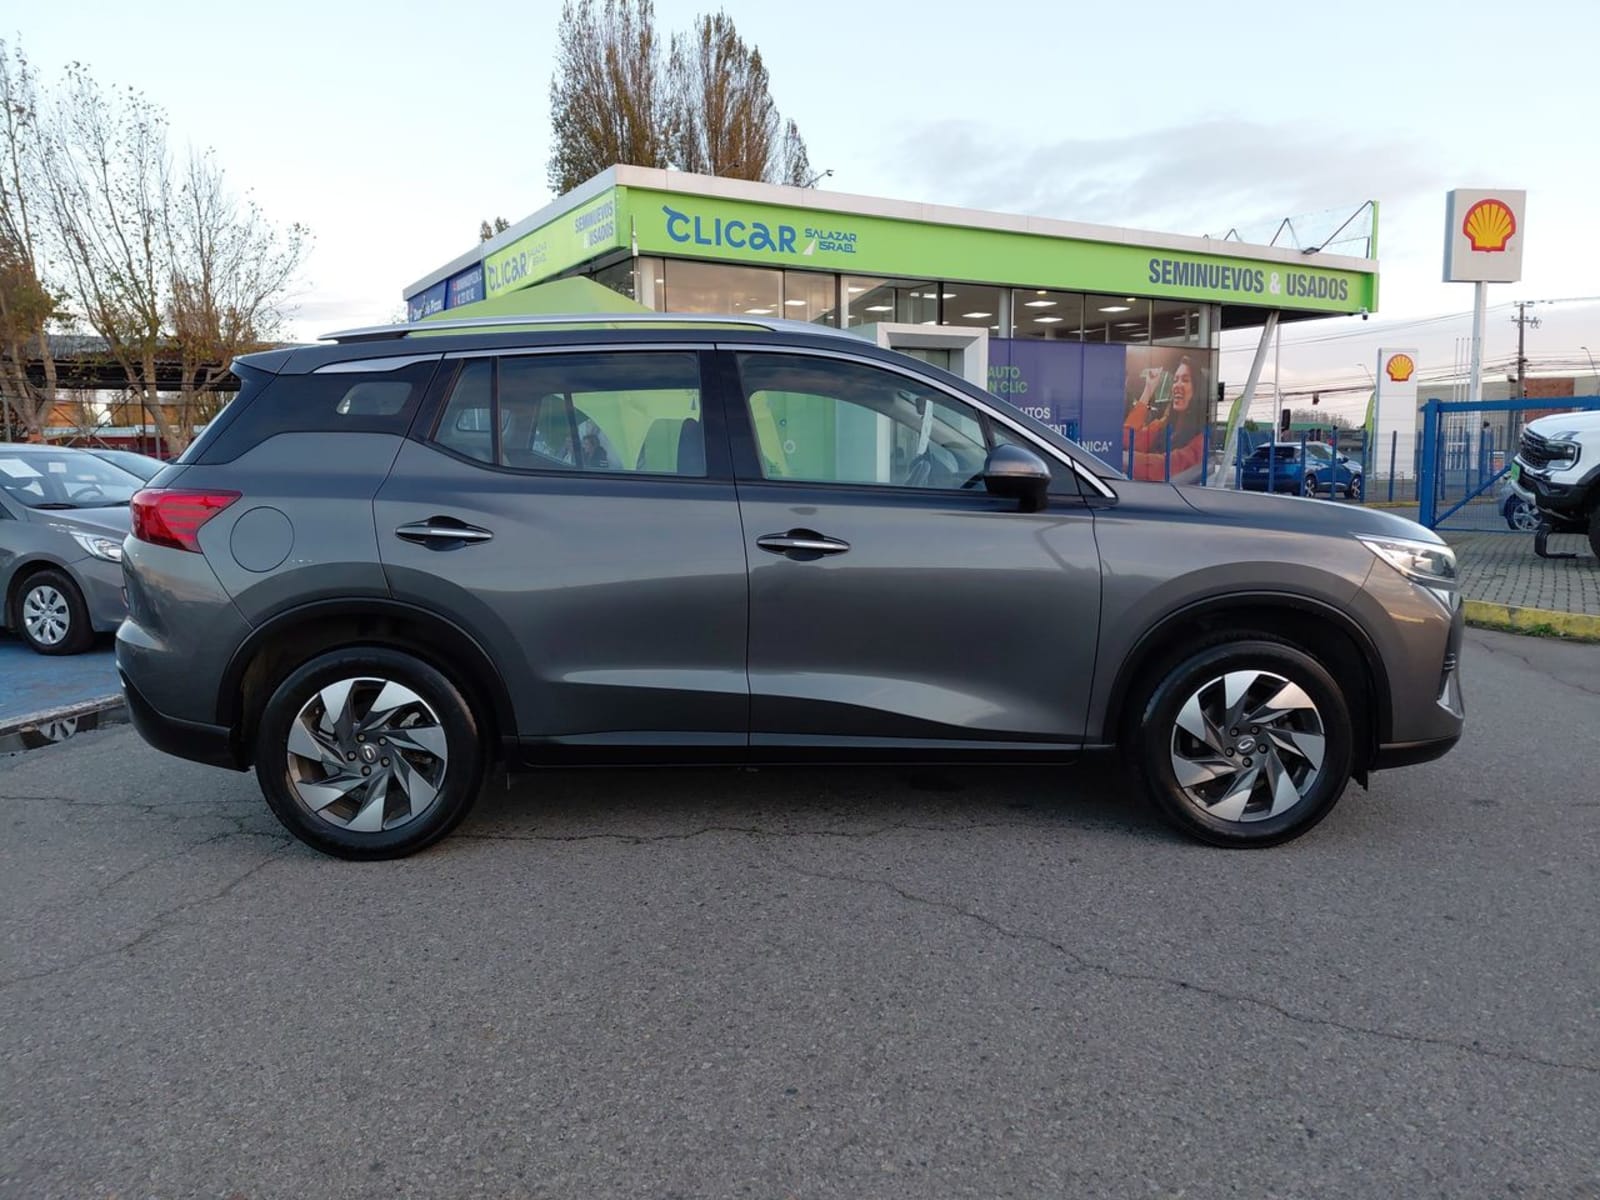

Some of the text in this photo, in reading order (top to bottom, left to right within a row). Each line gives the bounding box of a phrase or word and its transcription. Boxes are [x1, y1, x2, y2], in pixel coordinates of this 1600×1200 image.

[805, 228, 857, 243] SALAZAR
[819, 241, 857, 253] ISRAEL
[1149, 258, 1348, 301] SEMINUEVOS & USADOS
[987, 366, 1020, 378] AUTO
[1001, 380, 1028, 393] CLIC
